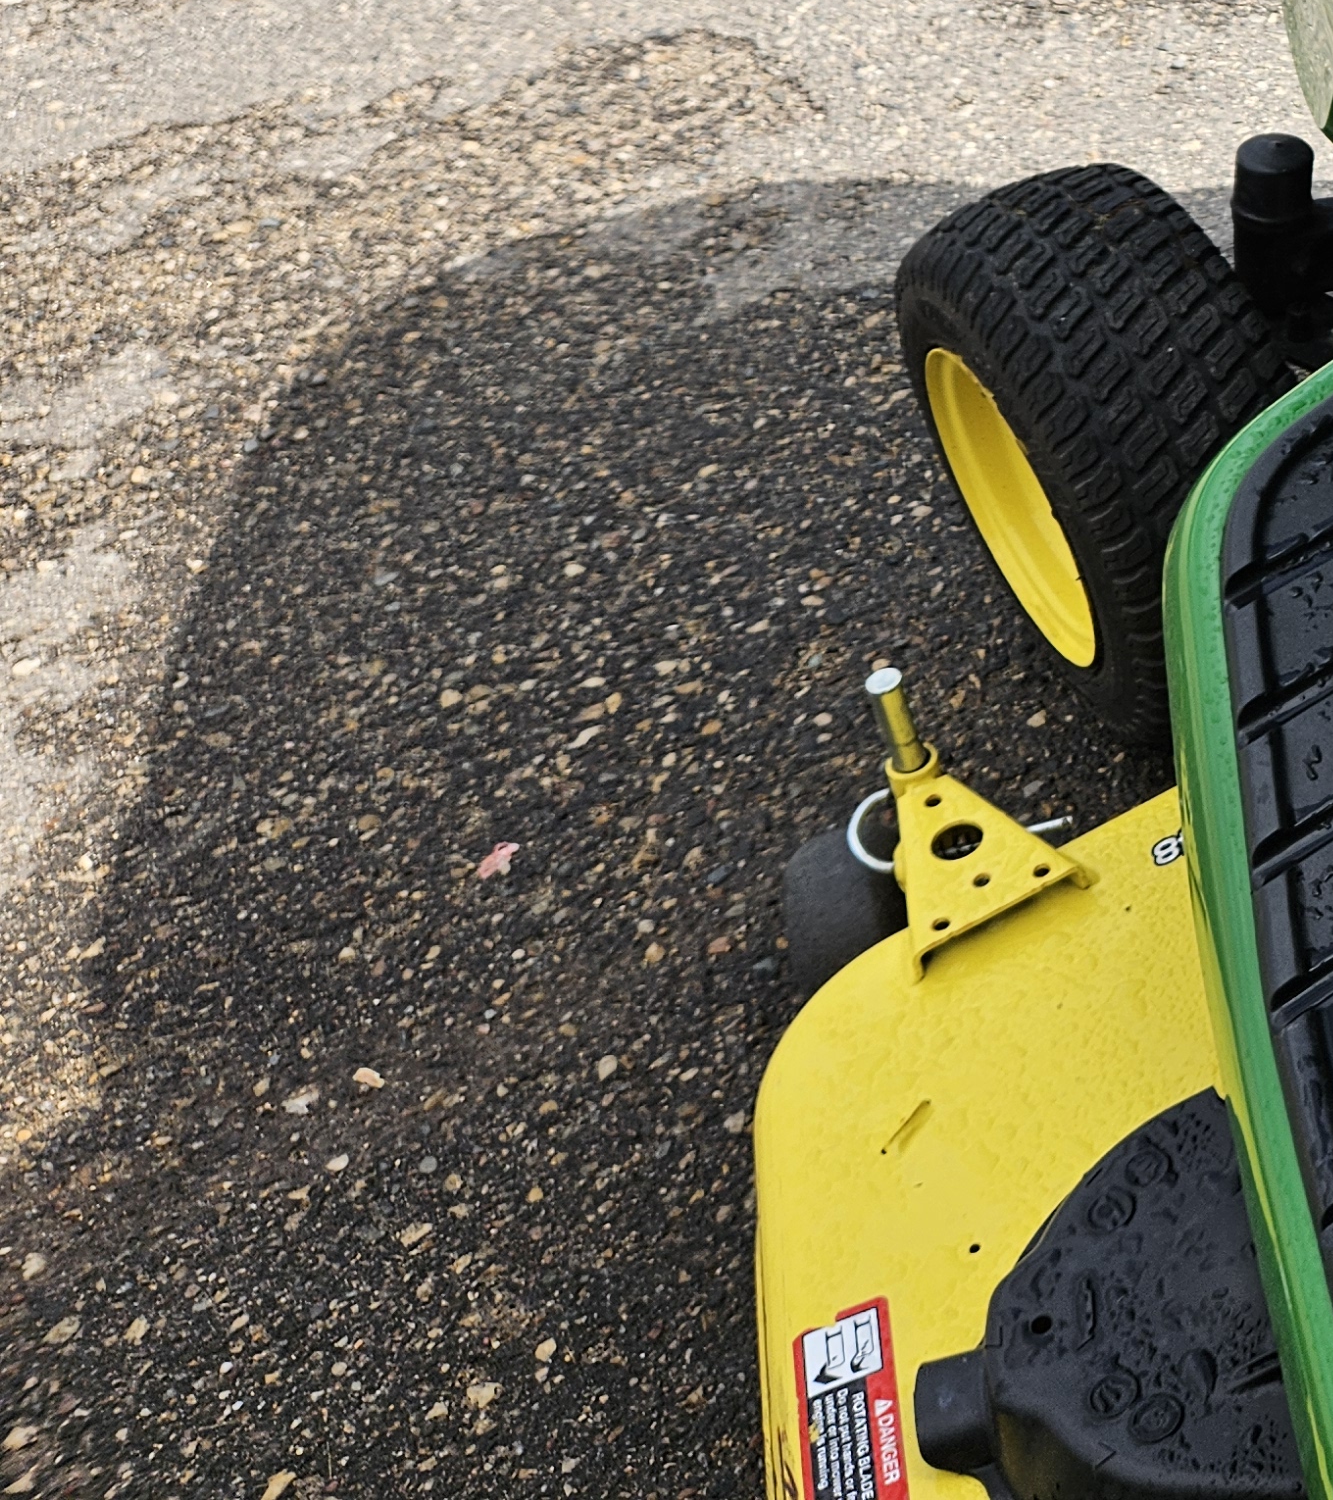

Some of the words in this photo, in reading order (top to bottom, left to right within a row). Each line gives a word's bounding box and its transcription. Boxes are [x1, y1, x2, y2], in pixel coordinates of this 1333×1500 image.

[824, 1393, 836, 1424] under
[837, 1388, 848, 1402] Do
[839, 1405, 849, 1424] not
[852, 1392, 869, 1457] ROTATING
[829, 1437, 839, 1460] into
[842, 1442, 855, 1477] hands
[878, 1413, 900, 1486] DANGER
[817, 1446, 830, 1490] running
[831, 1460, 842, 1497] mower
[858, 1456, 874, 1500] BLADE
